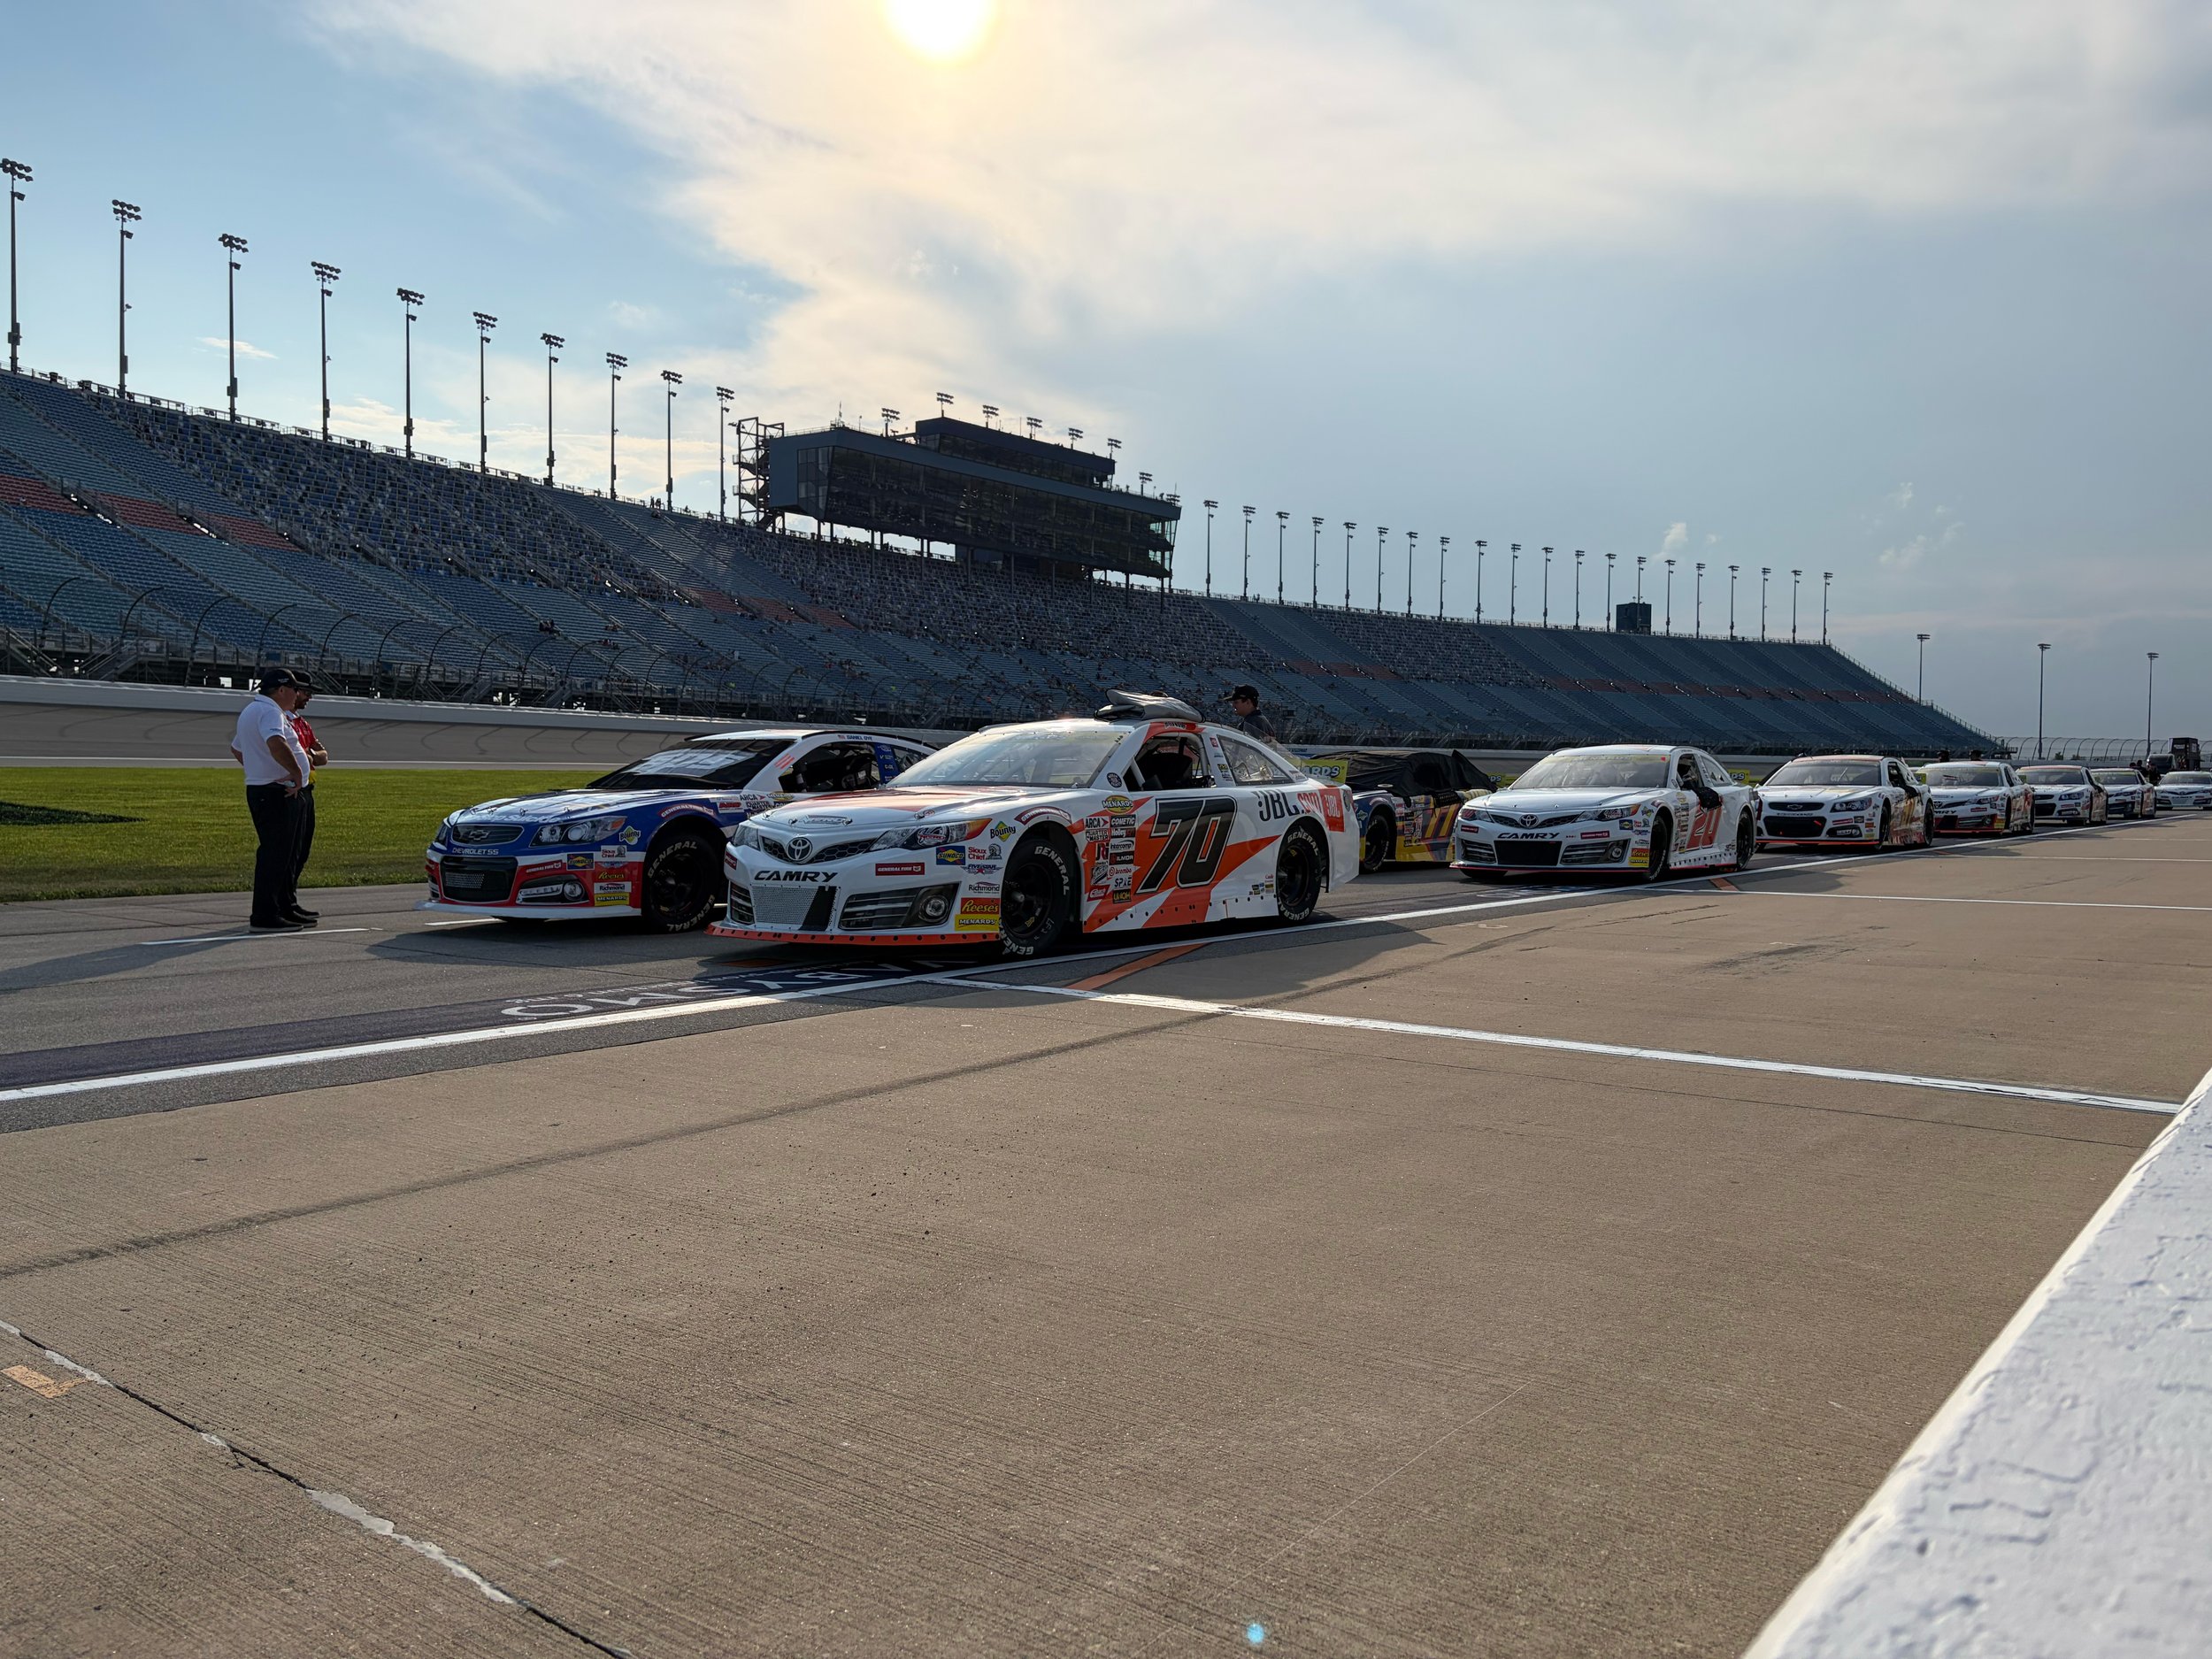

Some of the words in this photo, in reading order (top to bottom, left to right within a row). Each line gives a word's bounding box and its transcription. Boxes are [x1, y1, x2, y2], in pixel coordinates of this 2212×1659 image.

[1325, 795, 1340, 818] JBL
[990, 826, 1017, 839] Bounty
[1086, 818, 1101, 828] ARCA
[1134, 795, 1237, 895] 70
[1287, 831, 1319, 856] GENERAL
[648, 841, 698, 878] GENERAL
[1034, 846, 1070, 895] GENERAL
[754, 870, 839, 883] CAMRY
[962, 899, 998, 912] Reese's
